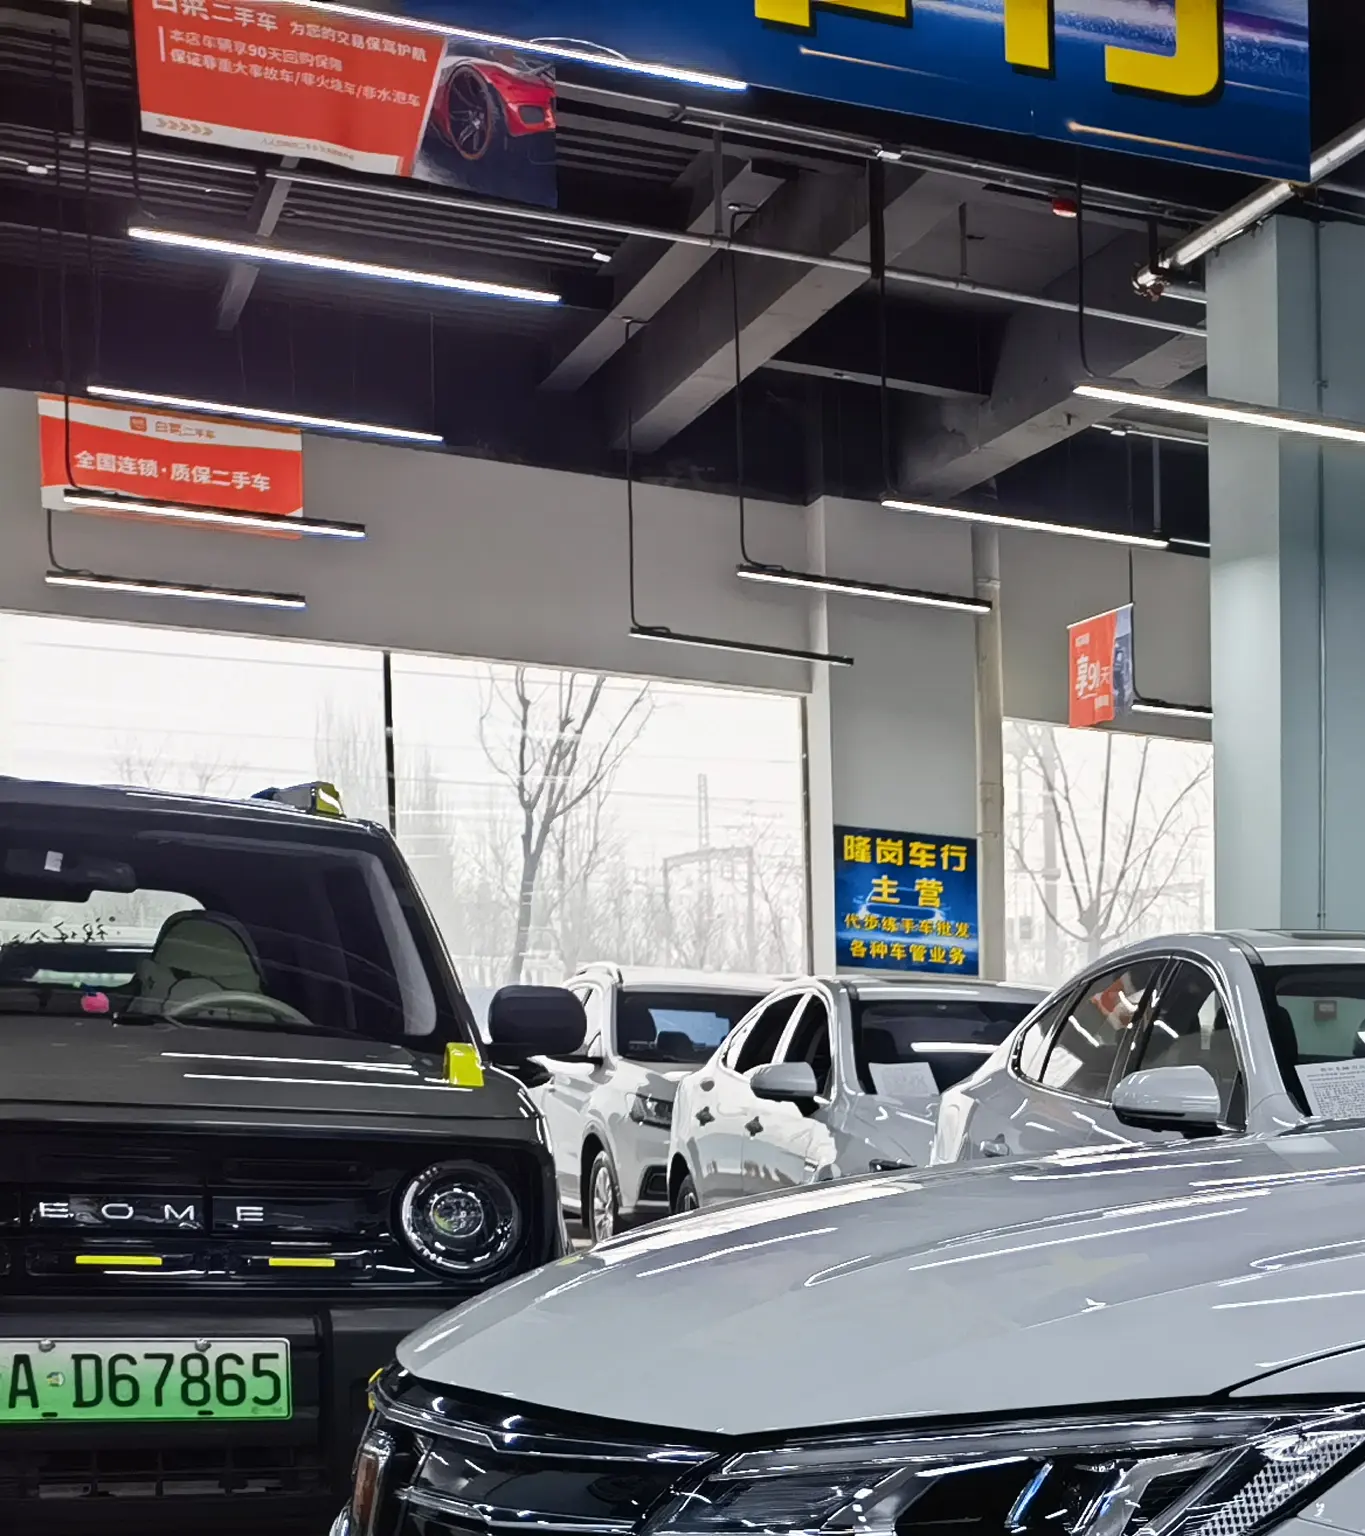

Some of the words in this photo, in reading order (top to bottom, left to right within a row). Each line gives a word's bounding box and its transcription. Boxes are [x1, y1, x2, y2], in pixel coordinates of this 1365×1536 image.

[74, 450, 271, 492] 全国连锁·质保二手车
[843, 834, 967, 872] 隆岗车行
[844, 912, 970, 938] 代步练手车批发
[849, 938, 966, 965] 各种车管业务
